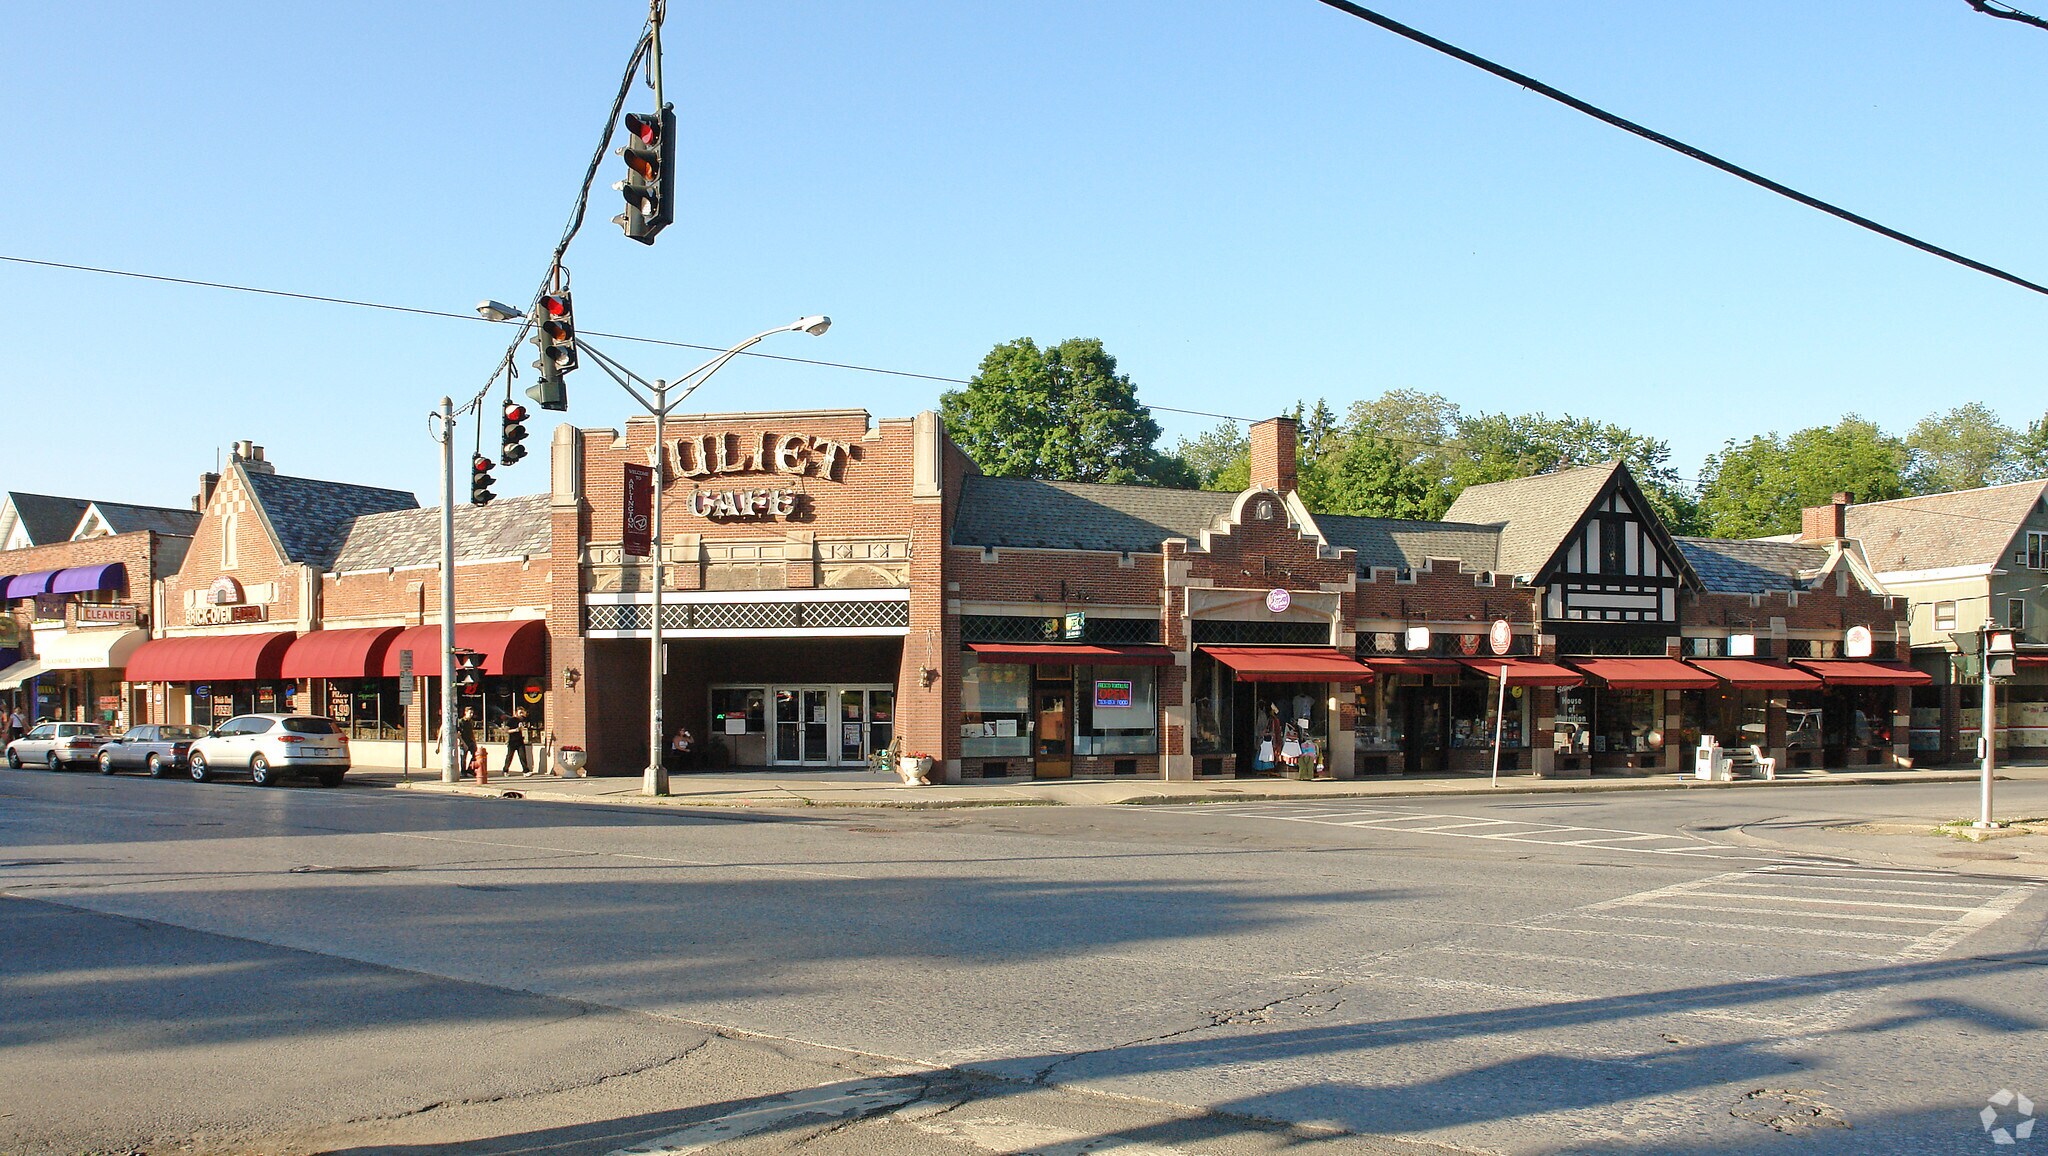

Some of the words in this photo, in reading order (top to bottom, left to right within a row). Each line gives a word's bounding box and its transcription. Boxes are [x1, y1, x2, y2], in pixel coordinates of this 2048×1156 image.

[687, 488, 795, 517] CAFE
[85, 609, 132, 621] CLEANERS
[1099, 689, 1129, 700] OPEN
[1561, 697, 1582, 705] House
[1568, 704, 1575, 713] of
